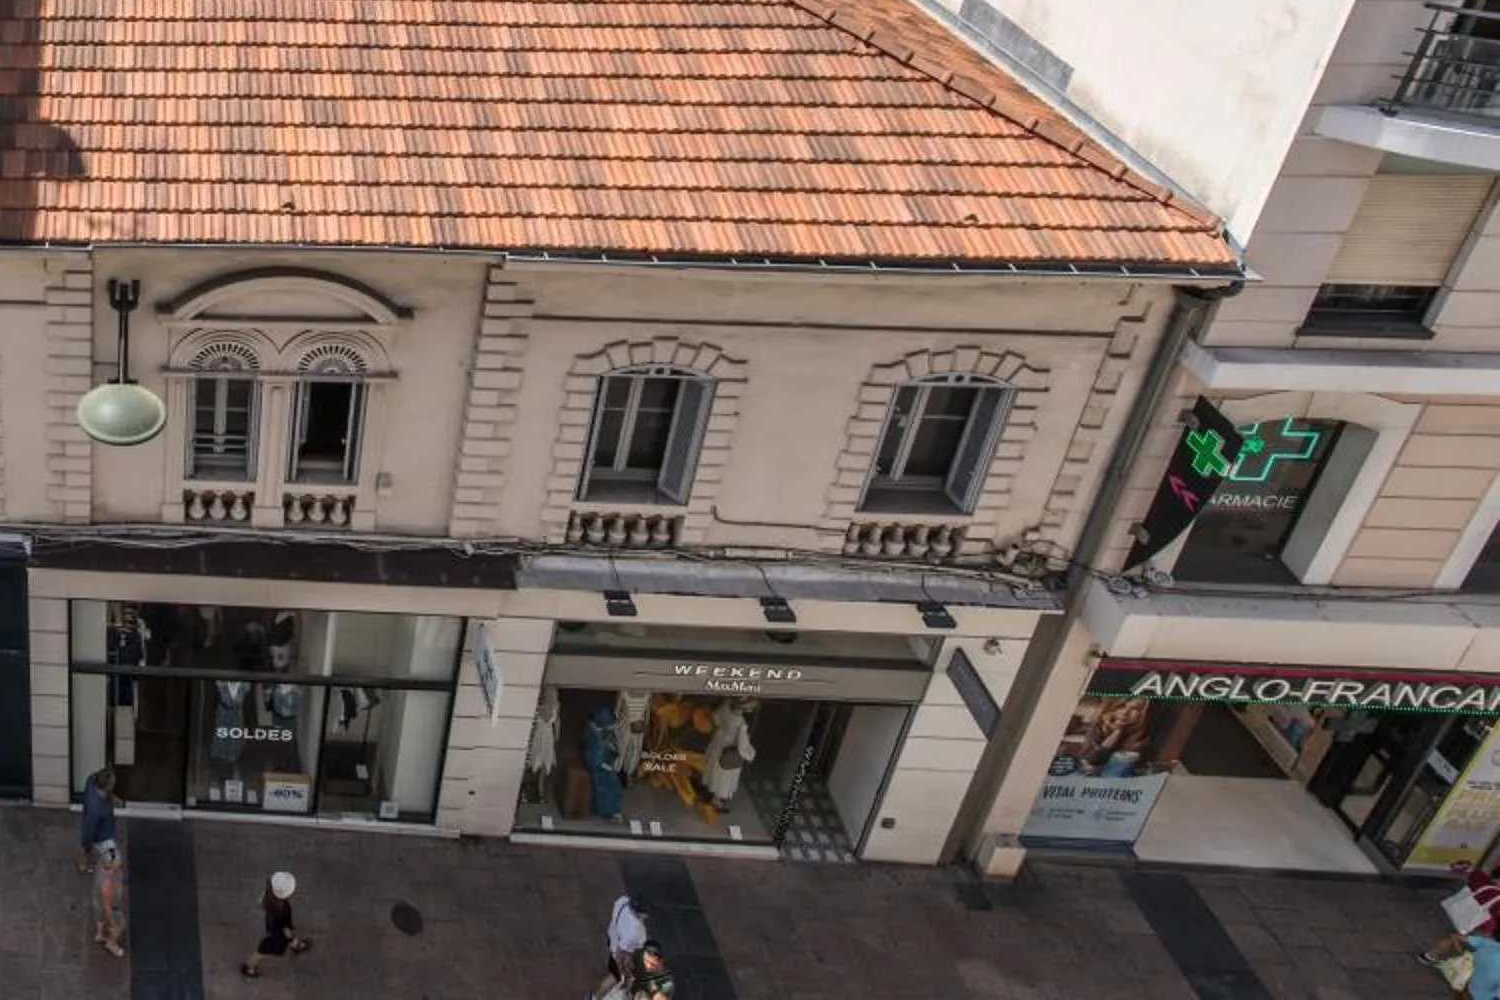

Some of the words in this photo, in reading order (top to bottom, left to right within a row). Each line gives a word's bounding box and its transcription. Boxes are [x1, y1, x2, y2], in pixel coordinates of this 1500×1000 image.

[1210, 493, 1299, 509] ARMACIE
[675, 665, 802, 680] WEEKEND
[216, 727, 293, 742] SOLDES
[1043, 785, 1076, 799] VITAL
[1081, 787, 1144, 804] PROTEINS
